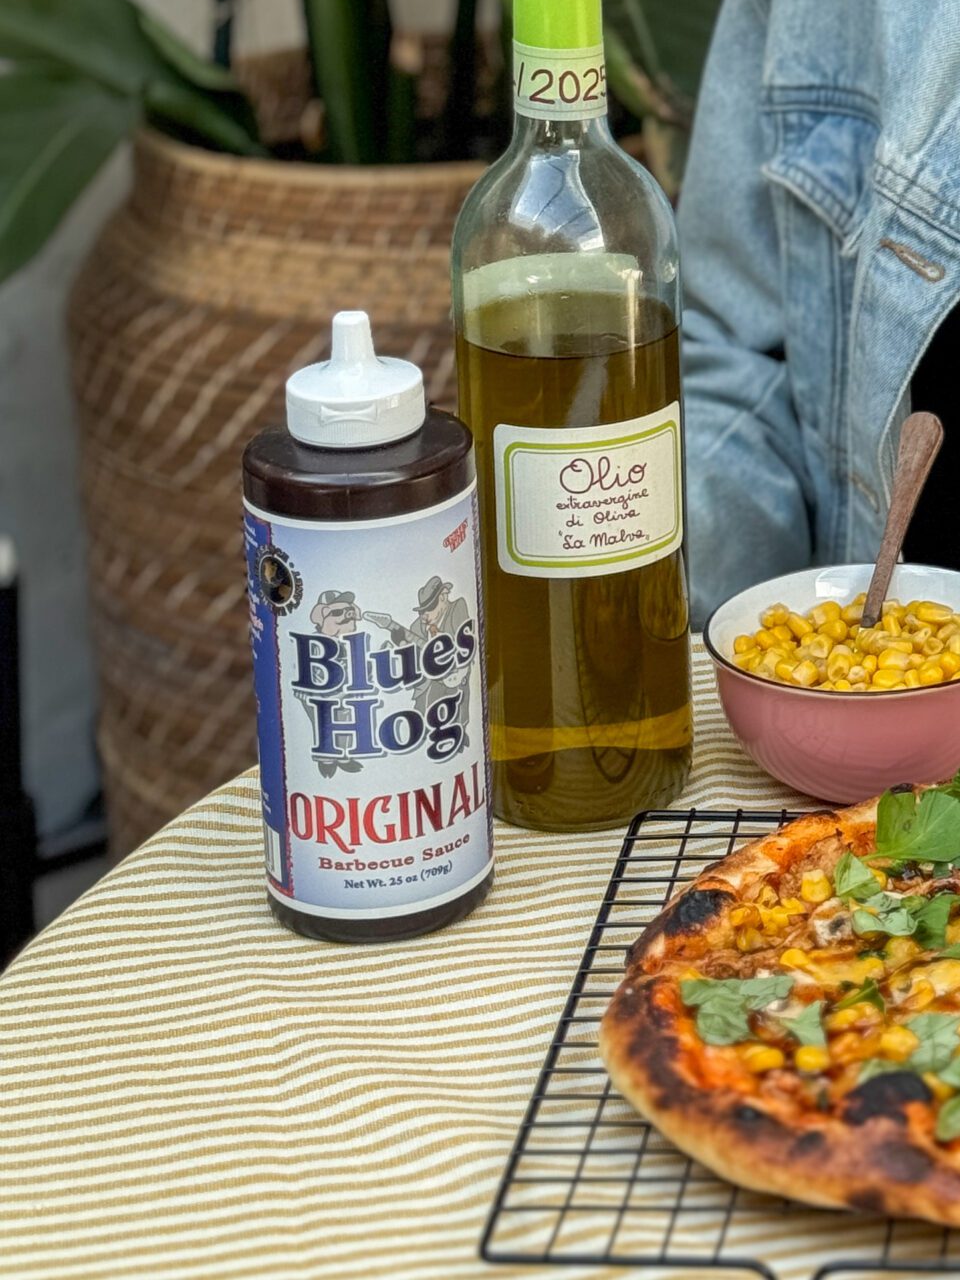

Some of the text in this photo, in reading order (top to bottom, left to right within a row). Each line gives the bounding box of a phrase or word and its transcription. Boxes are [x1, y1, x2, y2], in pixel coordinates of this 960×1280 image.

[559, 456, 647, 494] Olio
[556, 488, 649, 510] extravergine
[565, 508, 641, 527] di Oliva
[288, 618, 476, 693] Blues
[307, 690, 464, 762] Hog
[290, 761, 486, 854] ORIGINAL
[318, 833, 471, 872] Barbecue Sauce
[344, 860, 453, 889] Net Wt. 25 oz (709g)
